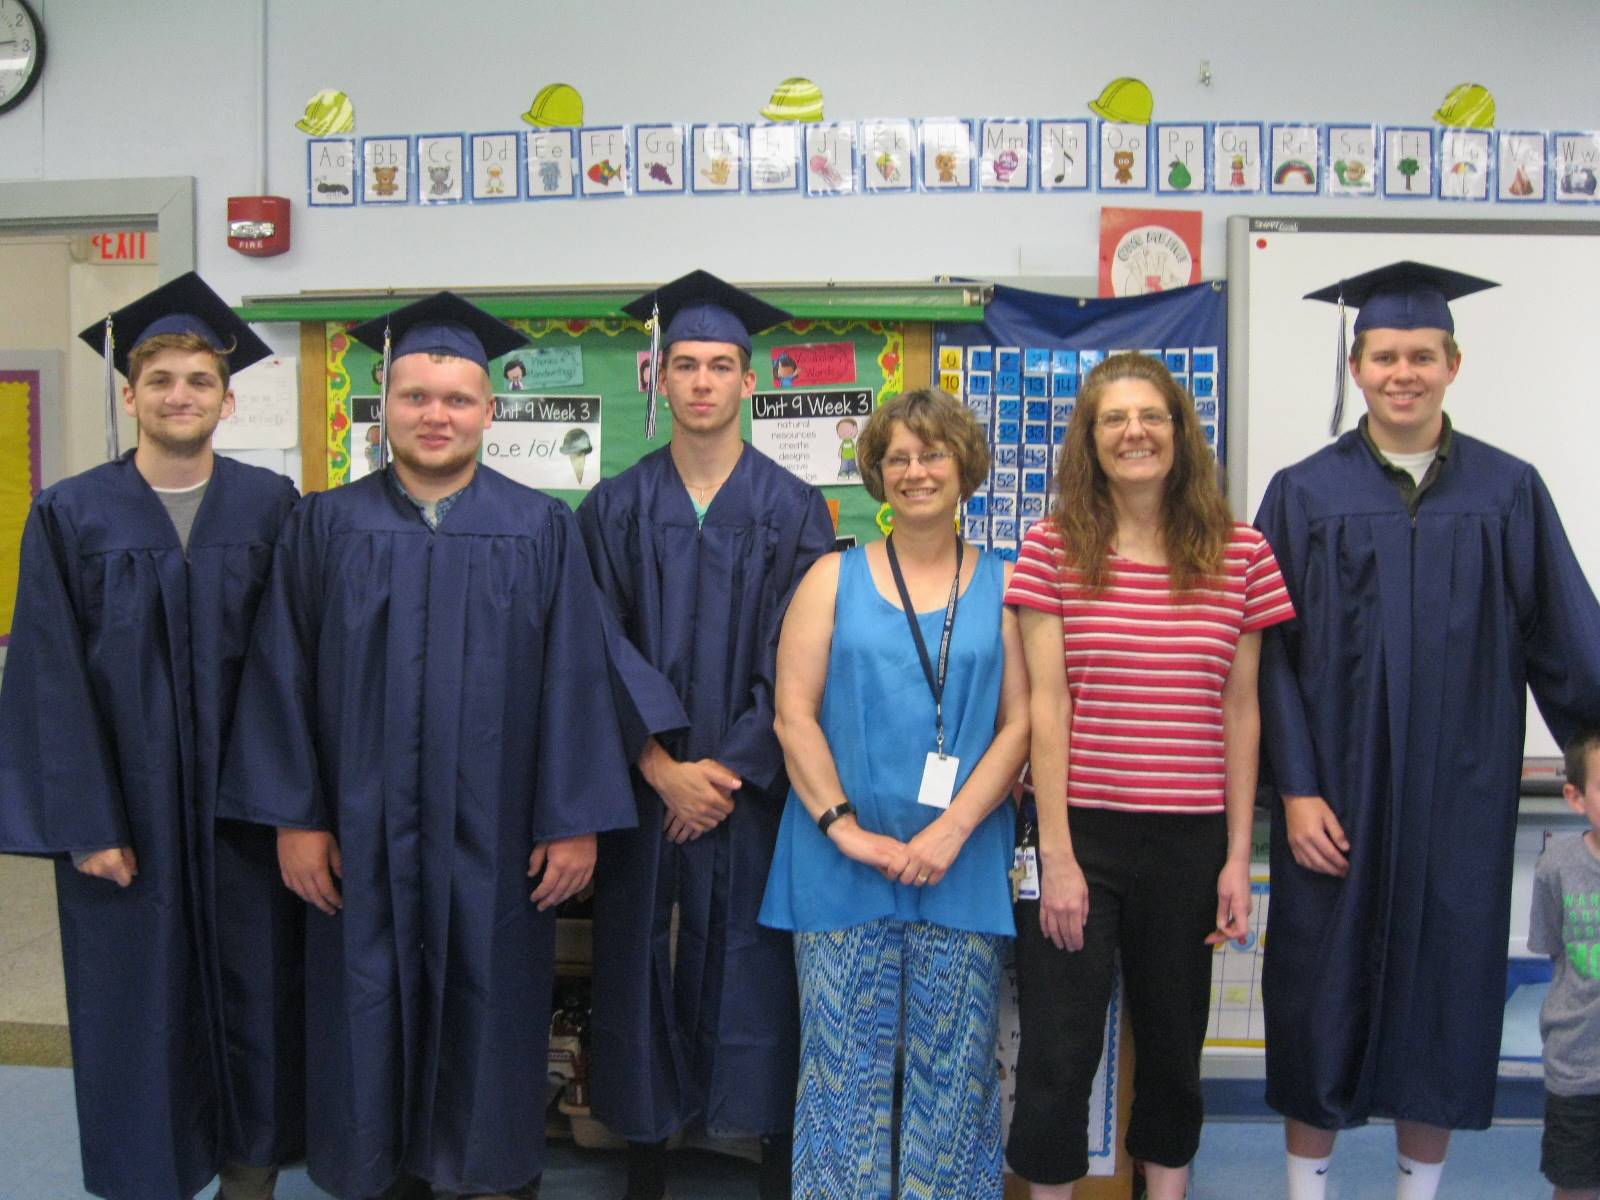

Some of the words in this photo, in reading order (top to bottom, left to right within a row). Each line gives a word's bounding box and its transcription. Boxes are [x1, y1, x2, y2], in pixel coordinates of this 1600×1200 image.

[15, 13, 24, 27] 2
[22, 38, 31, 53] 3
[319, 145, 345, 168] Aa
[373, 143, 398, 165] Bb
[482, 139, 507, 162] Dd
[590, 134, 614, 157] Ff
[645, 131, 675, 167] Gg
[987, 127, 1034, 150] Mm
[1050, 127, 1078, 149] Nn
[1108, 128, 1140, 150] Oo
[1168, 130, 1194, 165] Pp
[1221, 130, 1254, 167] Qq
[239, 240, 263, 249] FIRE
[1174, 354, 1183, 370] 8
[945, 376, 959, 390] 10
[973, 376, 985, 390] 11
[1001, 376, 1015, 390] 12
[1029, 379, 1043, 392] 13
[1056, 379, 1071, 393] 14
[1200, 379, 1213, 391] 19
[494, 401, 521, 419] Unit
[525, 402, 534, 418] 9
[538, 402, 576, 420] Week
[580, 402, 591, 420] 3
[755, 397, 788, 417] Unit
[792, 395, 803, 416] 9
[807, 394, 852, 417] Week
[857, 393, 869, 414] 3
[998, 401, 1017, 415] 22
[777, 418, 810, 429] natural
[771, 431, 816, 440] resources
[998, 425, 1016, 440] 32
[1027, 425, 1044, 439] 33
[779, 441, 809, 450] create
[779, 451, 810, 463] designs
[998, 474, 1015, 488] 52
[1027, 473, 1044, 487] 53
[996, 499, 1014, 513] 62
[1024, 498, 1042, 513] 63
[970, 519, 985, 535] 71
[996, 521, 1013, 537] 72
